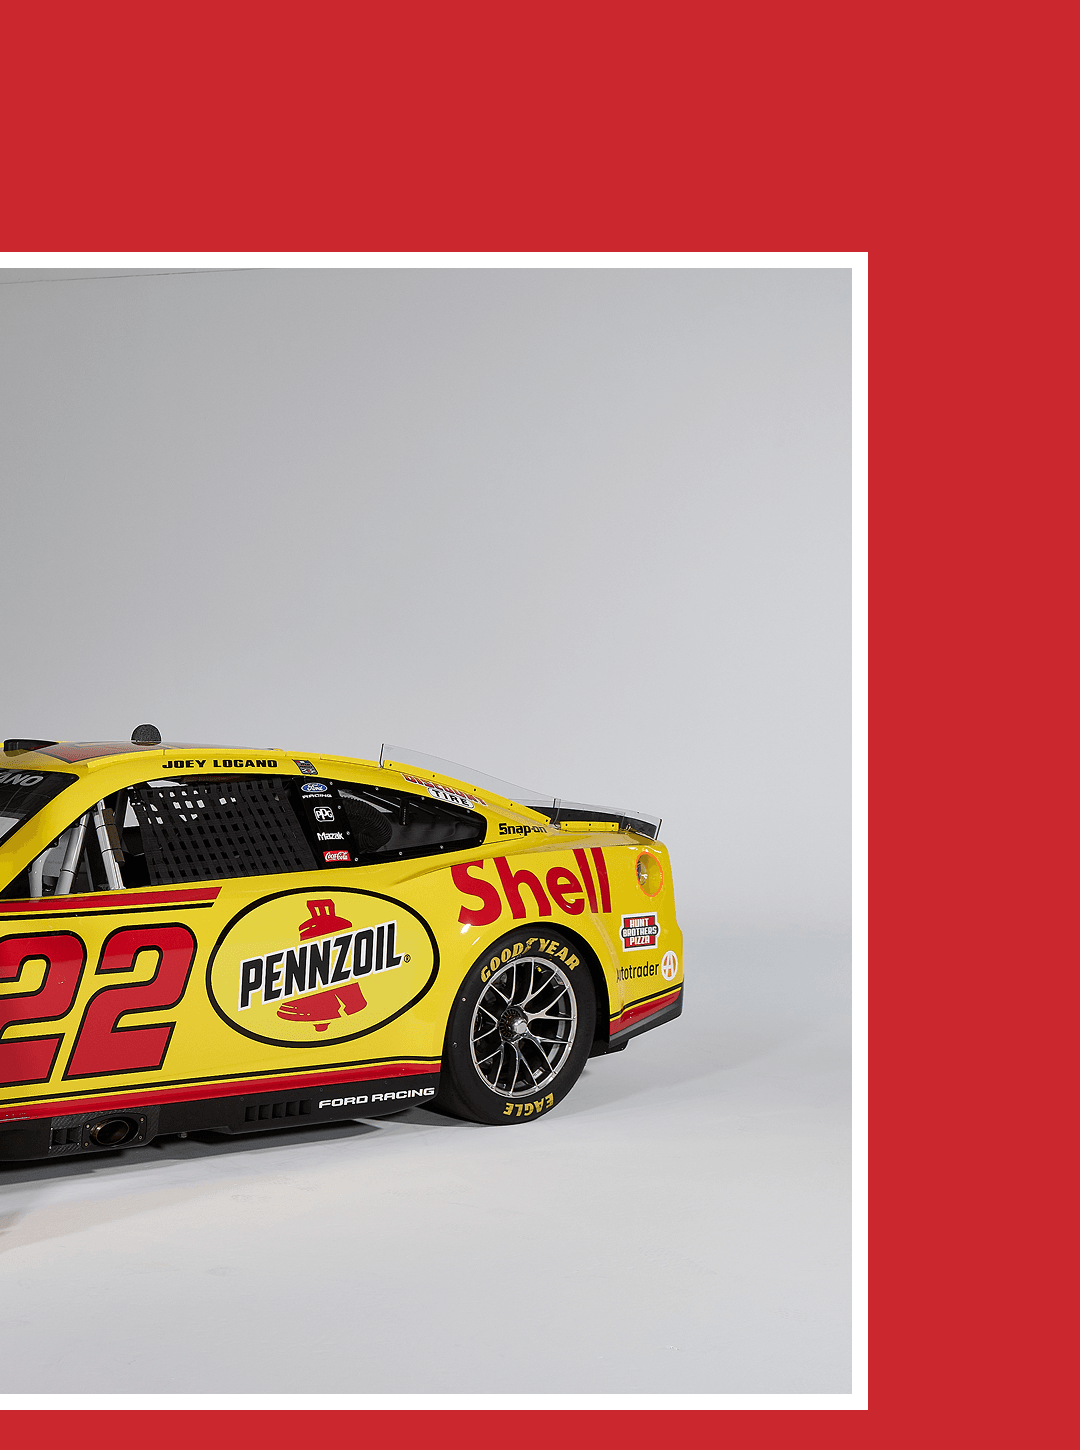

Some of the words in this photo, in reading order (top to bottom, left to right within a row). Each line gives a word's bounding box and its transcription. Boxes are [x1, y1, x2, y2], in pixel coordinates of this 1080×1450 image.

[162, 760, 206, 769] JOEY
[213, 759, 278, 768] LOGANO
[432, 789, 471, 807] TIRE
[315, 808, 334, 820] PPG
[499, 823, 548, 836] Snap-on
[317, 832, 344, 841] Mazak
[325, 851, 348, 861] Coca-Cola
[450, 847, 612, 926] Shell
[629, 918, 649, 927] HUNT
[622, 926, 657, 937] BROTHERS
[630, 935, 650, 946] PIZZA
[240, 922, 401, 1010] PENNZOIL
[319, 1095, 368, 1108] FORD
[371, 1087, 435, 1104] RACING
[502, 1092, 554, 1117] EAGLE
